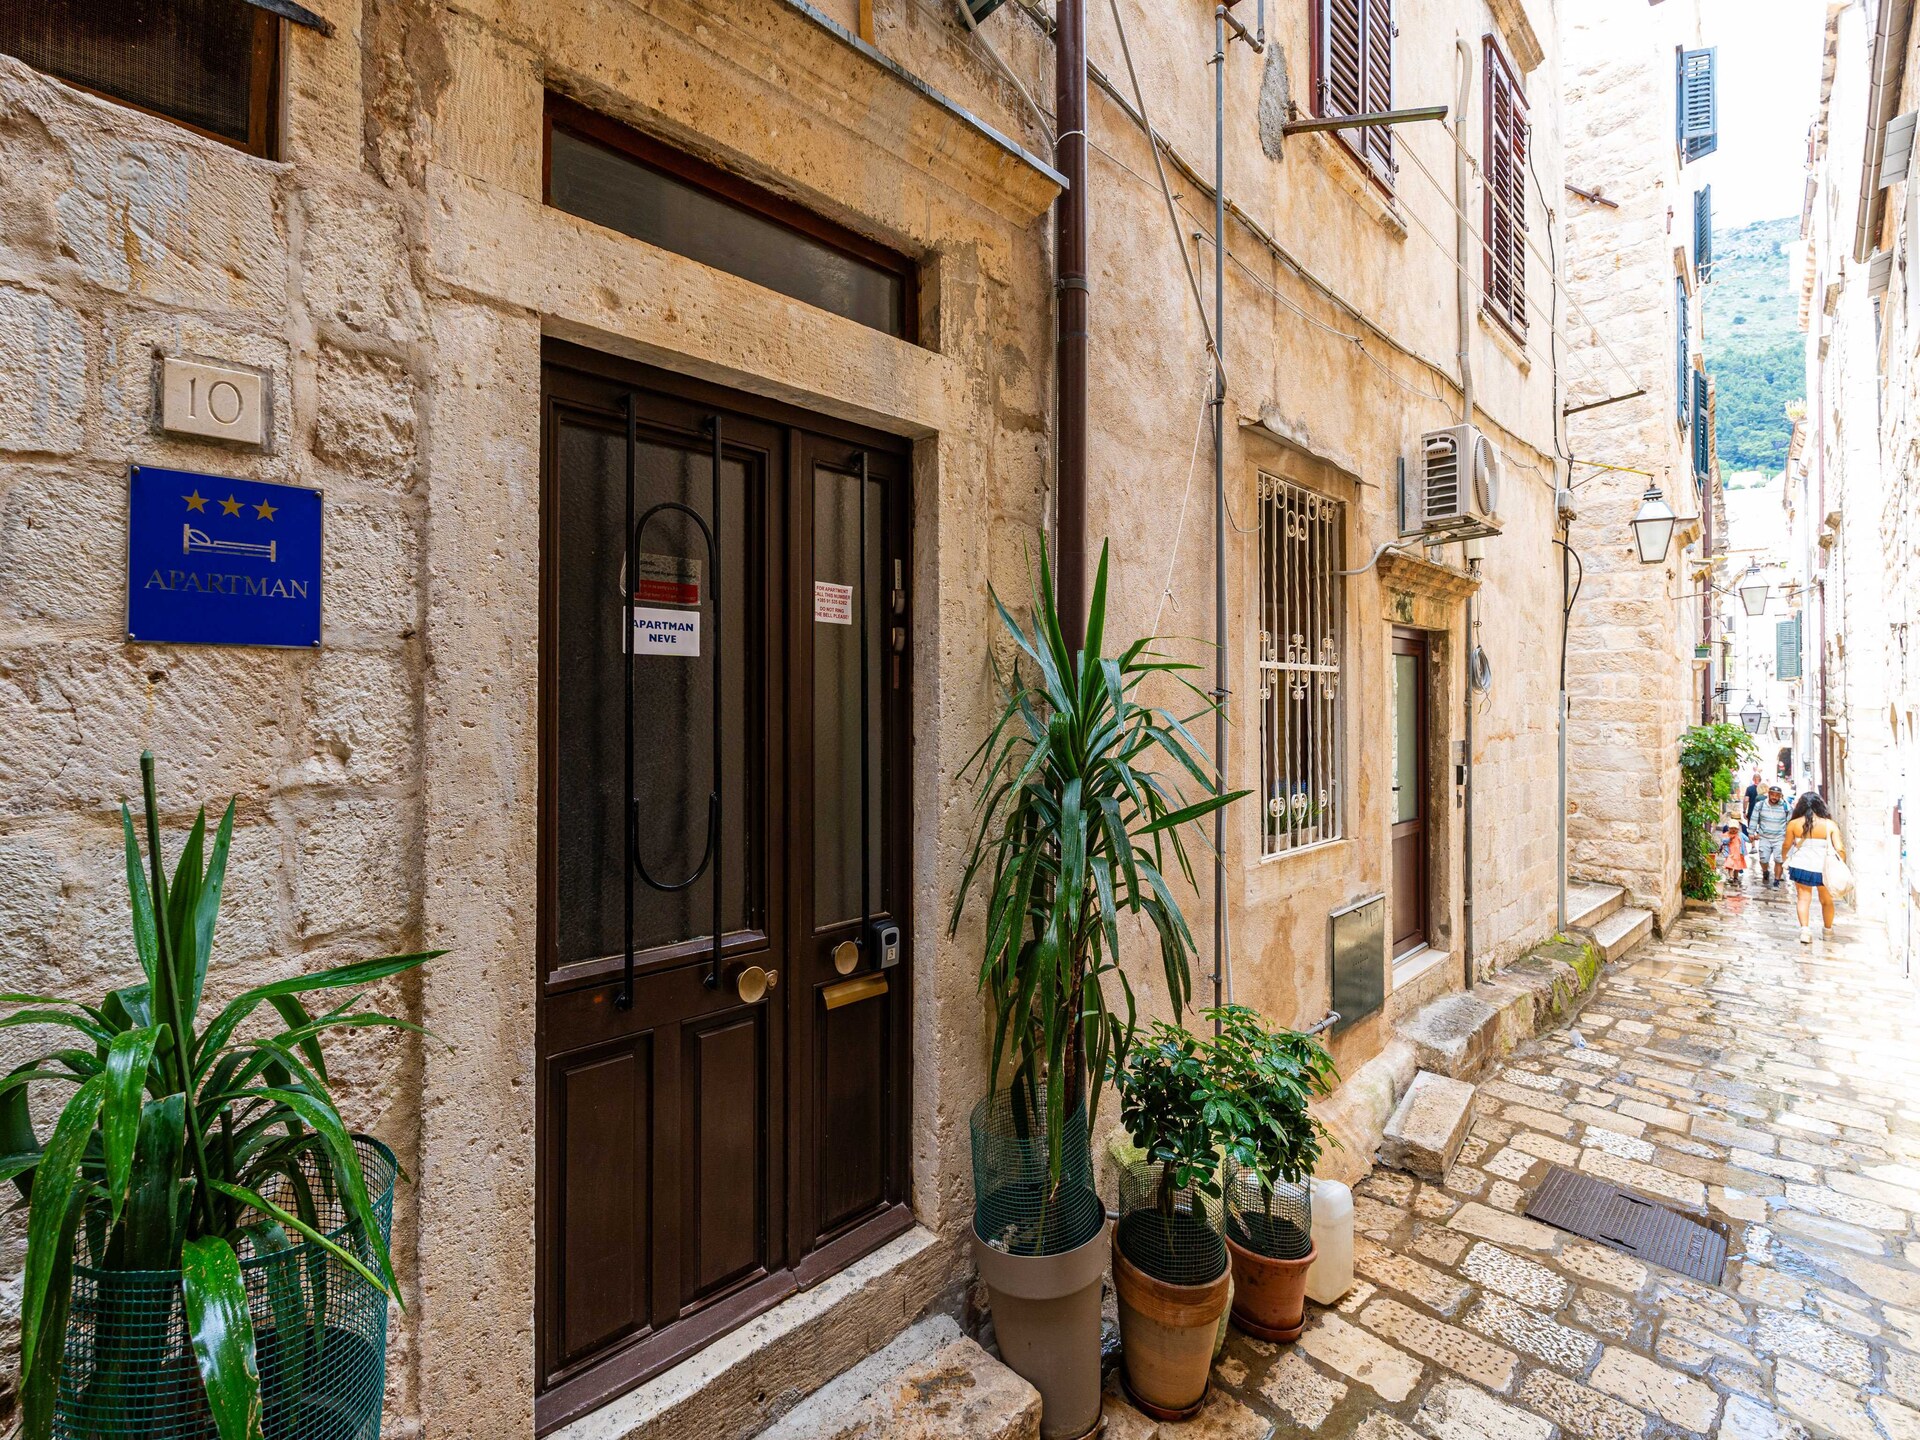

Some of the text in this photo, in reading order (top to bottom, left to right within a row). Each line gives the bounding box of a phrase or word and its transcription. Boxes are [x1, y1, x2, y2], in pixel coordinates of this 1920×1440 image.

[188, 377, 244, 426] 10
[144, 569, 309, 600] APARTMAN
[649, 633, 677, 644] NEVE
